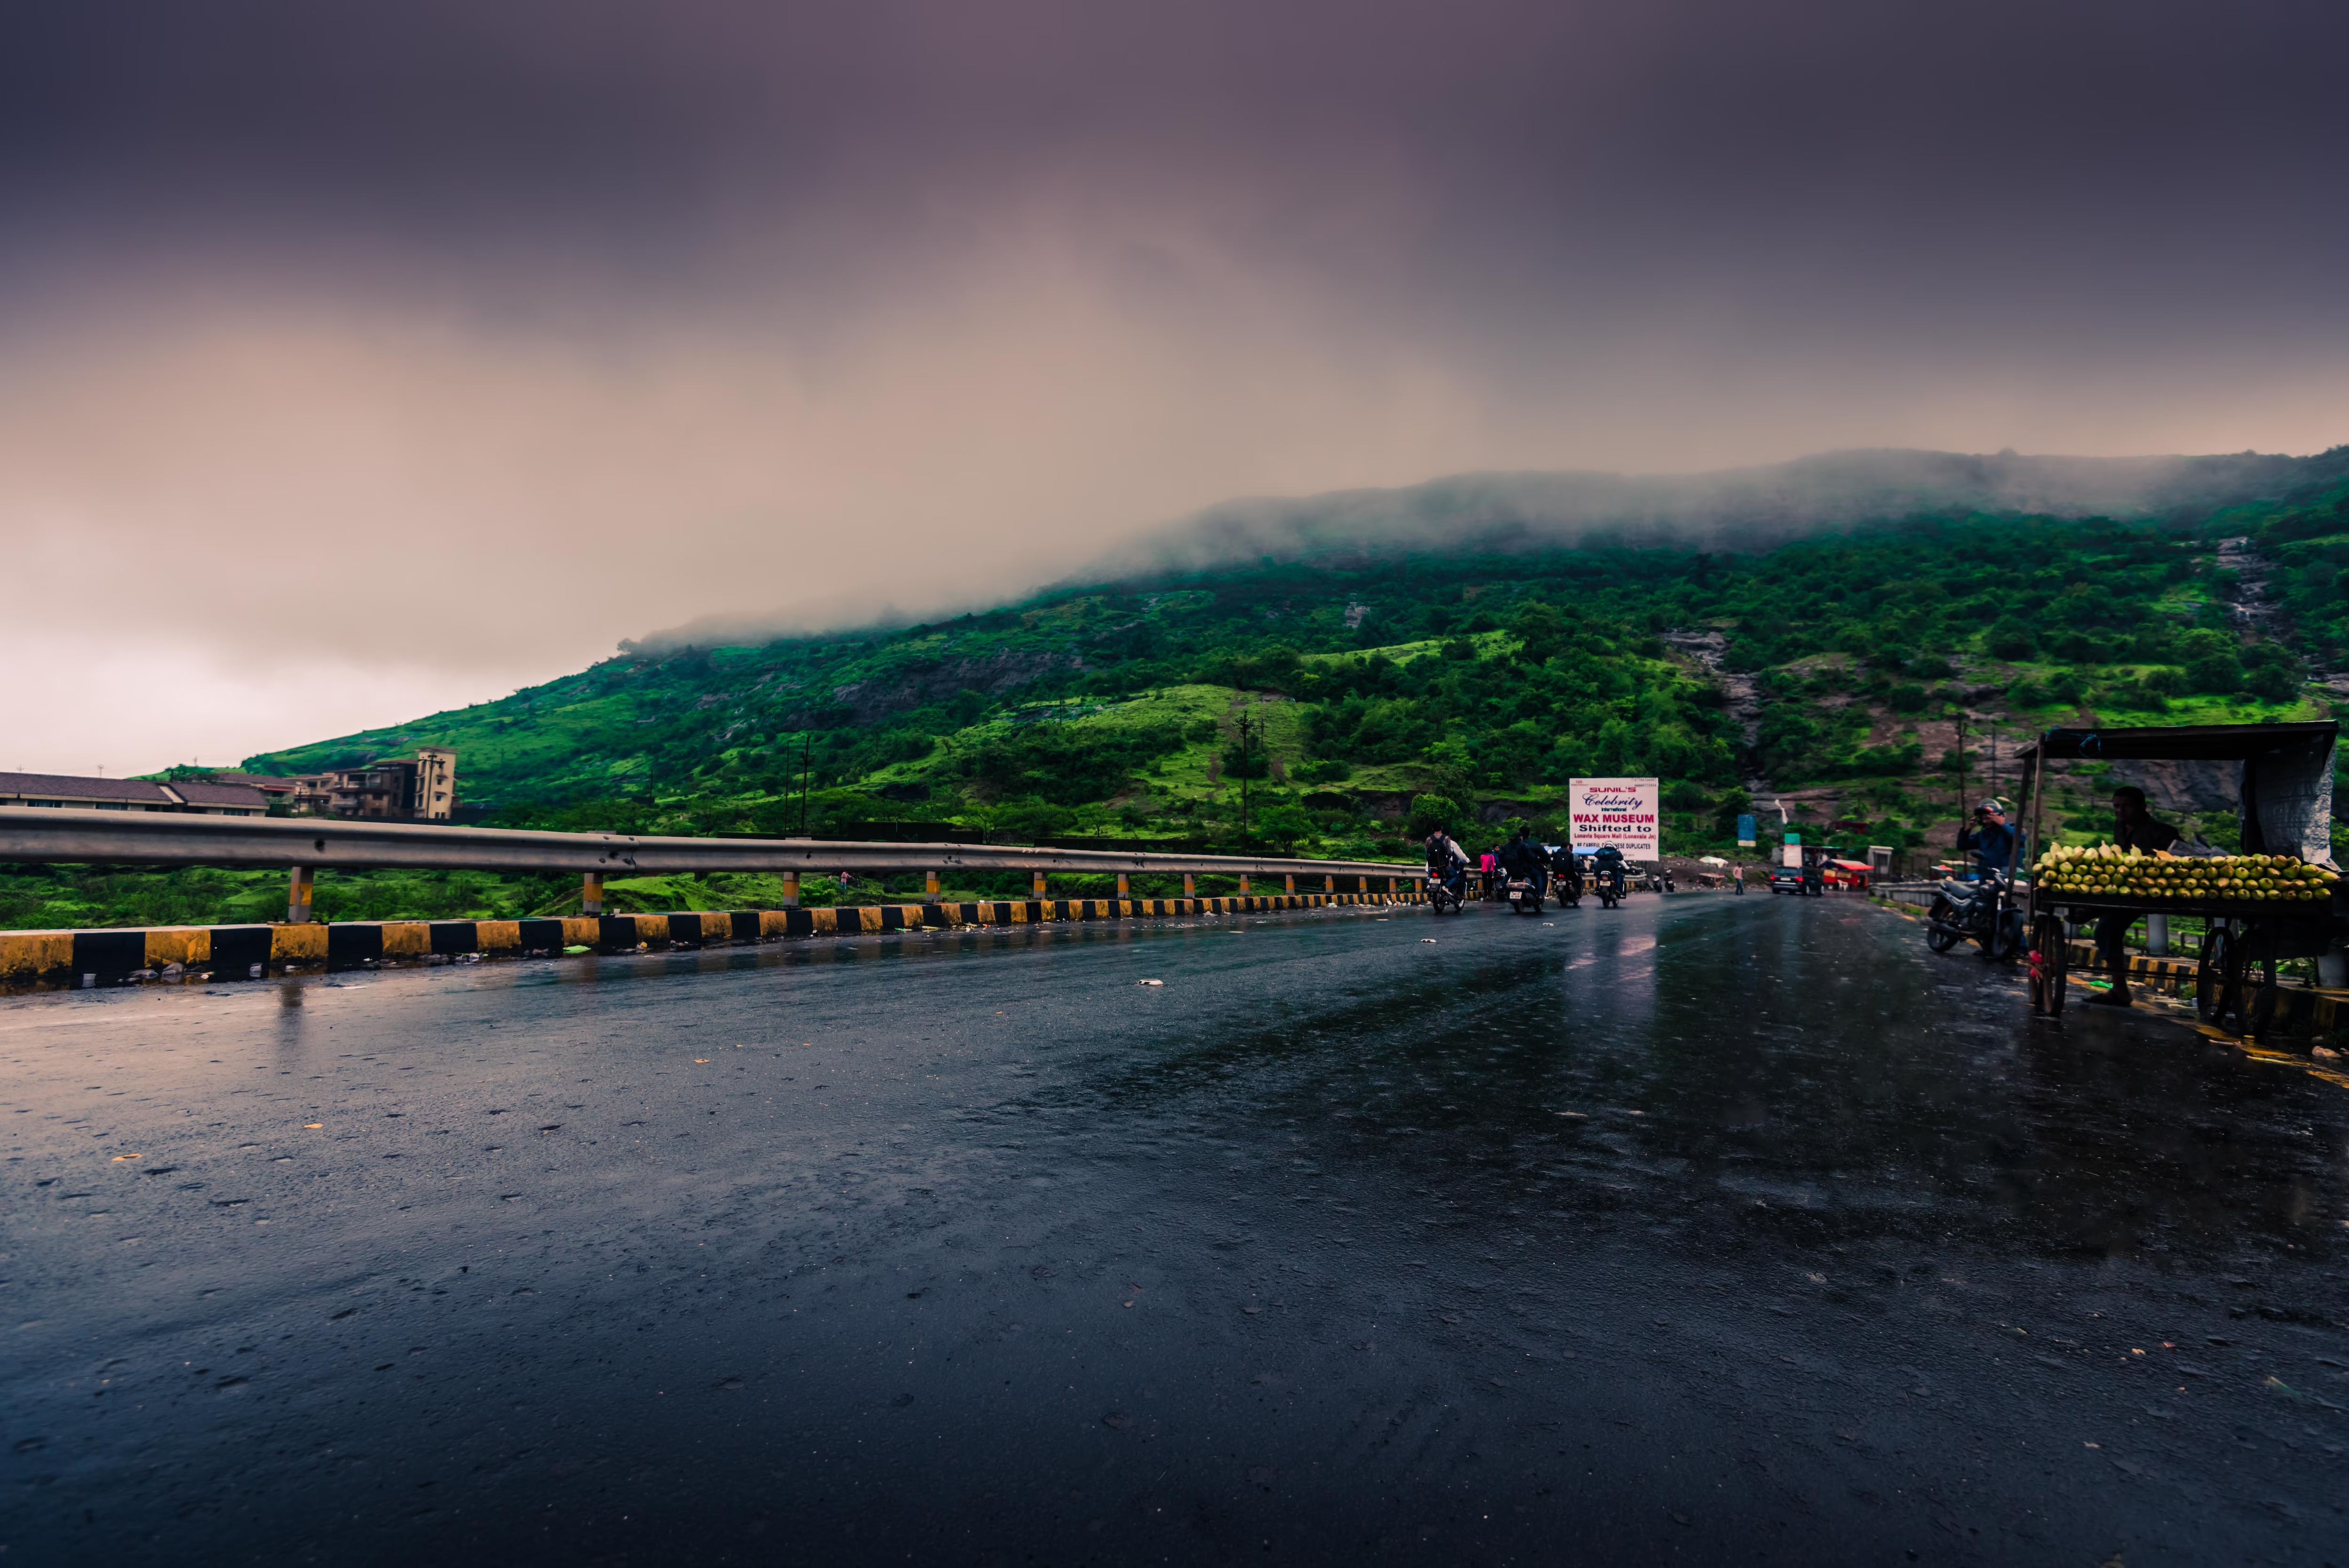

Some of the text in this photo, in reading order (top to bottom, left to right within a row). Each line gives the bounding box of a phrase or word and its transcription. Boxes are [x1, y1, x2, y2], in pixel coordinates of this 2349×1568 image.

[1582, 793, 1643, 810] Celebrity
[1573, 814, 1654, 823] WAX MUSEUM
